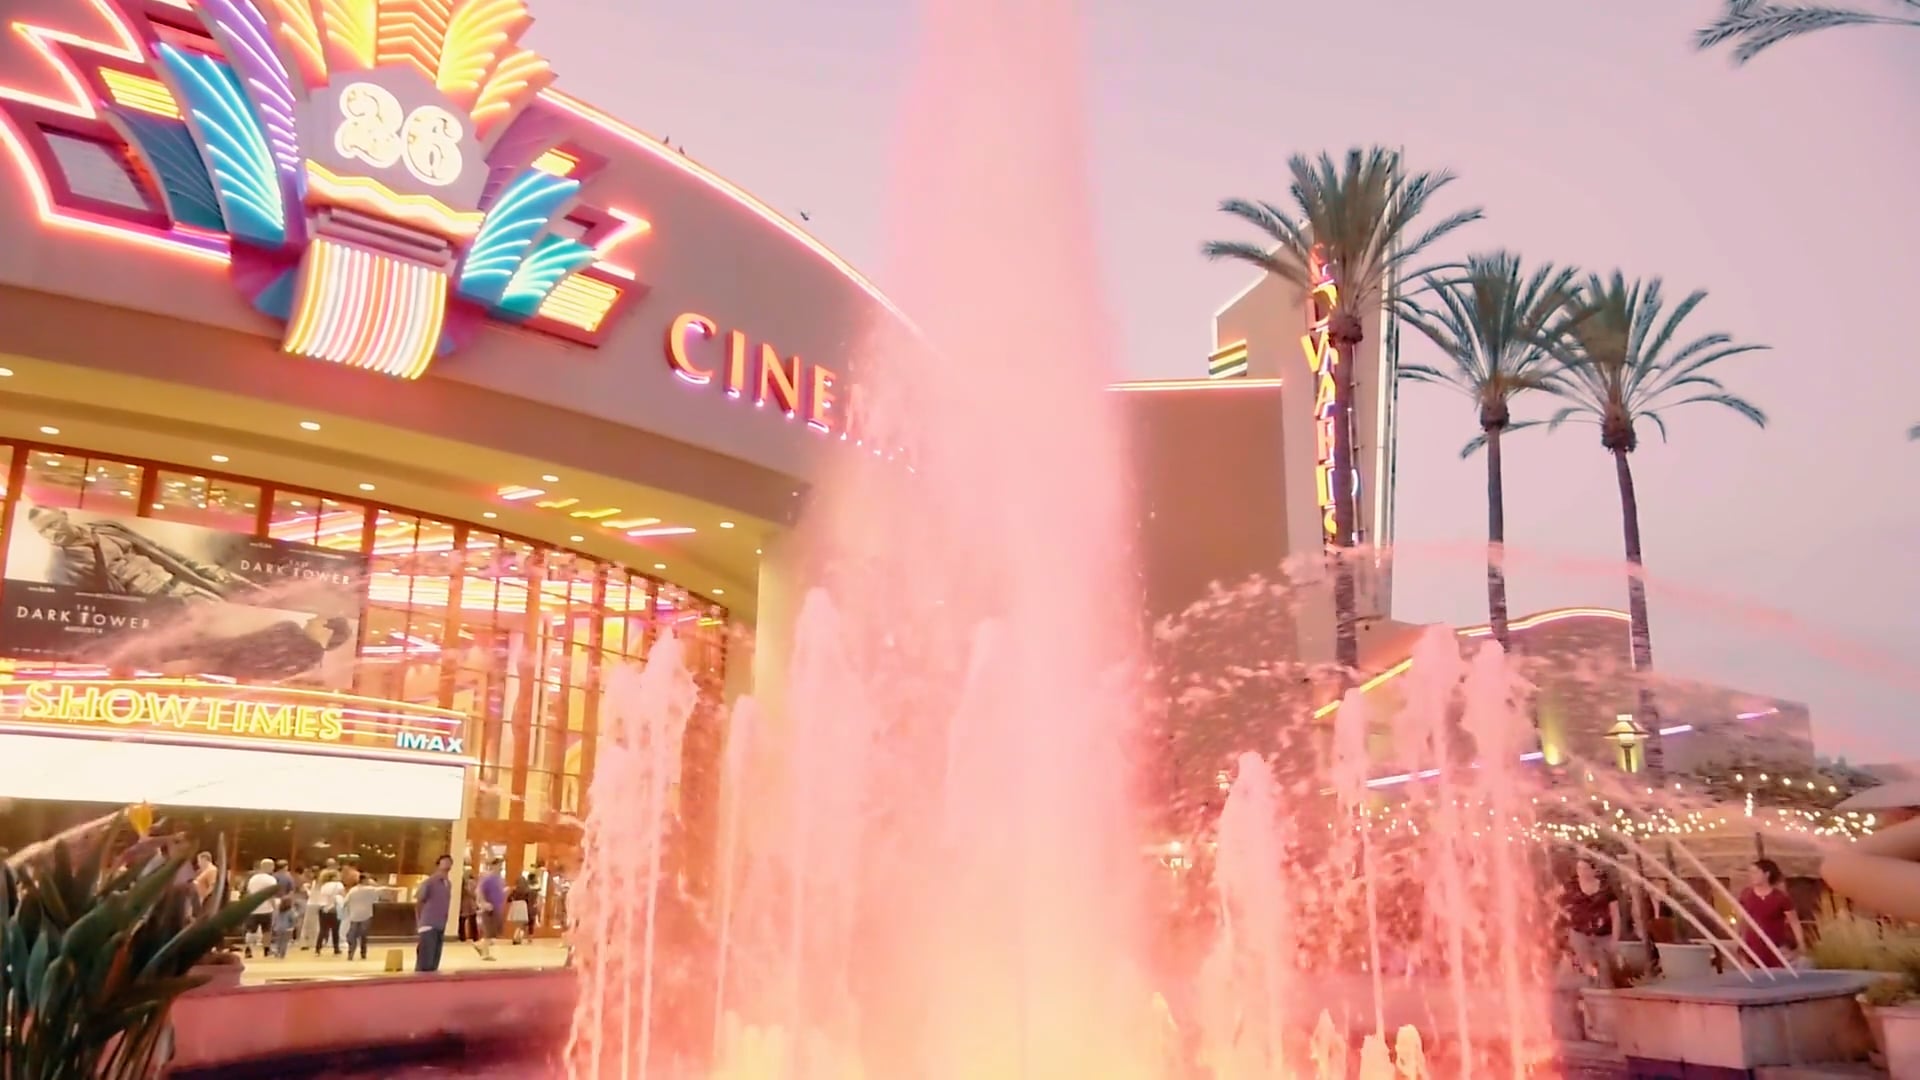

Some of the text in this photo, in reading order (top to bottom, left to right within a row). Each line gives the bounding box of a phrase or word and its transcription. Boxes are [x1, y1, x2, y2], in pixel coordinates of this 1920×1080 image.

[334, 82, 463, 186] 26
[664, 312, 890, 458] CINE
[240, 559, 286, 575] DARK
[292, 566, 350, 585] TOWER
[16, 606, 150, 629] DARK TOWER
[23, 682, 343, 741] SHOWTIMES
[396, 731, 464, 754] IMAX
